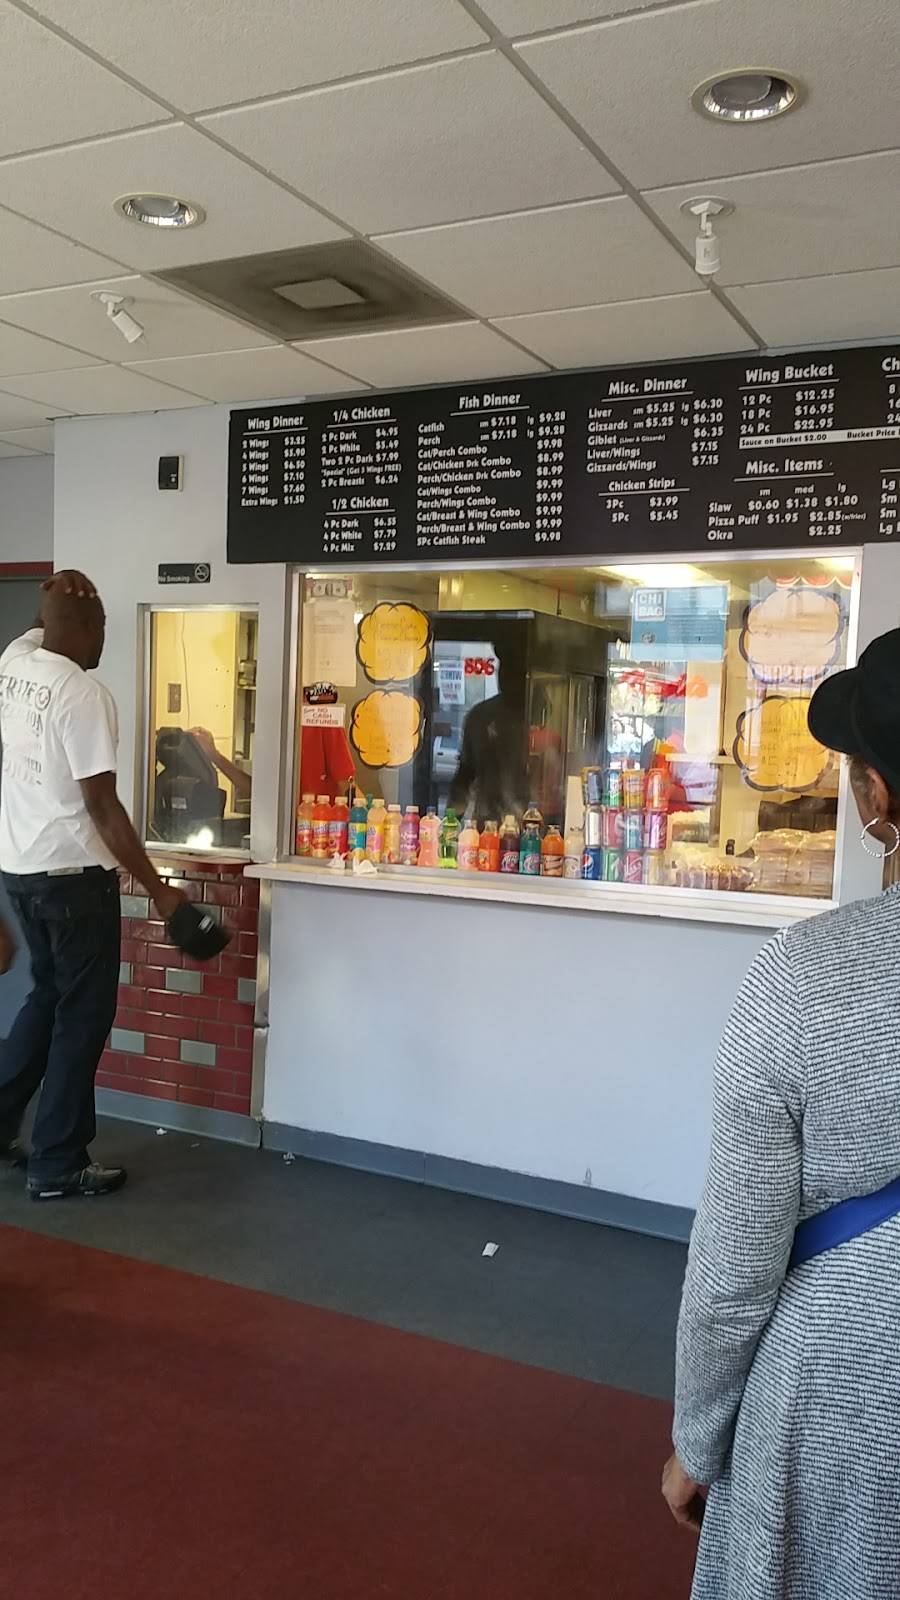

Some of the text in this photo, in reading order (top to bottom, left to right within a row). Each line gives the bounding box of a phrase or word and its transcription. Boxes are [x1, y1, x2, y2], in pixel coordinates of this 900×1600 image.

[745, 364, 834, 383] Wing Bucket
[608, 378, 687, 395] Misc. Dinner
[889, 384, 896, 394] 8
[459, 394, 520, 409] Fish Dinner
[743, 388, 835, 405] 12 Pc $12.25
[333, 406, 390, 422] 1/4 Chicken
[589, 408, 612, 419] Liver
[647, 402, 675, 414] $5.25
[694, 398, 723, 410] $6.30
[742, 403, 834, 420] 18 Pc $16.95
[248, 416, 304, 430] Wing Dinner
[418, 422, 445, 433] Catfish
[588, 413, 723, 432] Gizzards $5.25 $6.30
[740, 417, 833, 435] 24 Pc $22.95
[329, 432, 338, 441] Pc
[340, 430, 357, 440] Dark
[418, 436, 441, 446] Perch
[588, 435, 616, 446] Giblet
[804, 434, 827, 442] $2.00
[847, 429, 896, 439] Bucket Price
[249, 439, 269, 448] Wings
[329, 445, 338, 453] Pc
[340, 443, 360, 452] White
[587, 441, 718, 460] Liver/Wings $7.15
[249, 451, 269, 460] Wings
[321, 458, 336, 466] Two
[345, 456, 354, 464] Pc
[356, 454, 373, 463] Dark
[376, 452, 399, 462] $7.99
[418, 447, 455, 459] Cat/Perch
[458, 445, 487, 455] Combo
[249, 462, 269, 472] Wings
[418, 459, 464, 471] Cat/Chicken
[481, 457, 511, 466] Combo
[587, 455, 719, 473] Gizzards/Wings $7.15
[746, 459, 823, 474] Misc. Items
[249, 474, 269, 484] Wings
[283, 472, 305, 481] $7.10
[328, 478, 337, 487] Pc
[418, 472, 474, 484] Perch/Chicken
[491, 469, 522, 479] Combo
[242, 484, 305, 495] 7 Wings $7.60
[417, 479, 563, 496] Cat/Wings Combo $9.99
[609, 478, 675, 492] Chicken Strips
[795, 485, 814, 494] med
[882, 478, 896, 490] Lg
[260, 497, 278, 506] Wings
[332, 496, 389, 510] 1/2 Chicken
[417, 493, 563, 509] Perch/Wings Combo $9.99
[606, 499, 624, 509] 3Pc
[709, 502, 732, 513] Slaw
[748, 500, 780, 511] $0.60
[786, 498, 818, 508] $1.38
[881, 493, 897, 504] Sm
[417, 511, 456, 521] Cat/Breast
[468, 510, 487, 520] Wing
[490, 508, 520, 518] Combo
[536, 506, 562, 516] $9.99
[708, 516, 734, 527] Pizza
[738, 514, 759, 525] Puff
[767, 512, 799, 524] $1.95
[880, 508, 896, 518] Sm
[324, 518, 359, 528] 4 Pc Dark
[417, 523, 466, 534] Perch/Breast
[477, 522, 497, 532] Wing
[500, 520, 530, 530] Combo
[536, 519, 562, 529] $9.99
[879, 522, 893, 534] Lg
[324, 529, 396, 540] 4 Pc White $7.79
[433, 535, 459, 545] Catfish
[462, 534, 486, 544] Steak
[708, 525, 842, 540] Okra $2.25
[323, 544, 328, 552] 4
[330, 543, 339, 552] Pc
[341, 542, 354, 551] Mix
